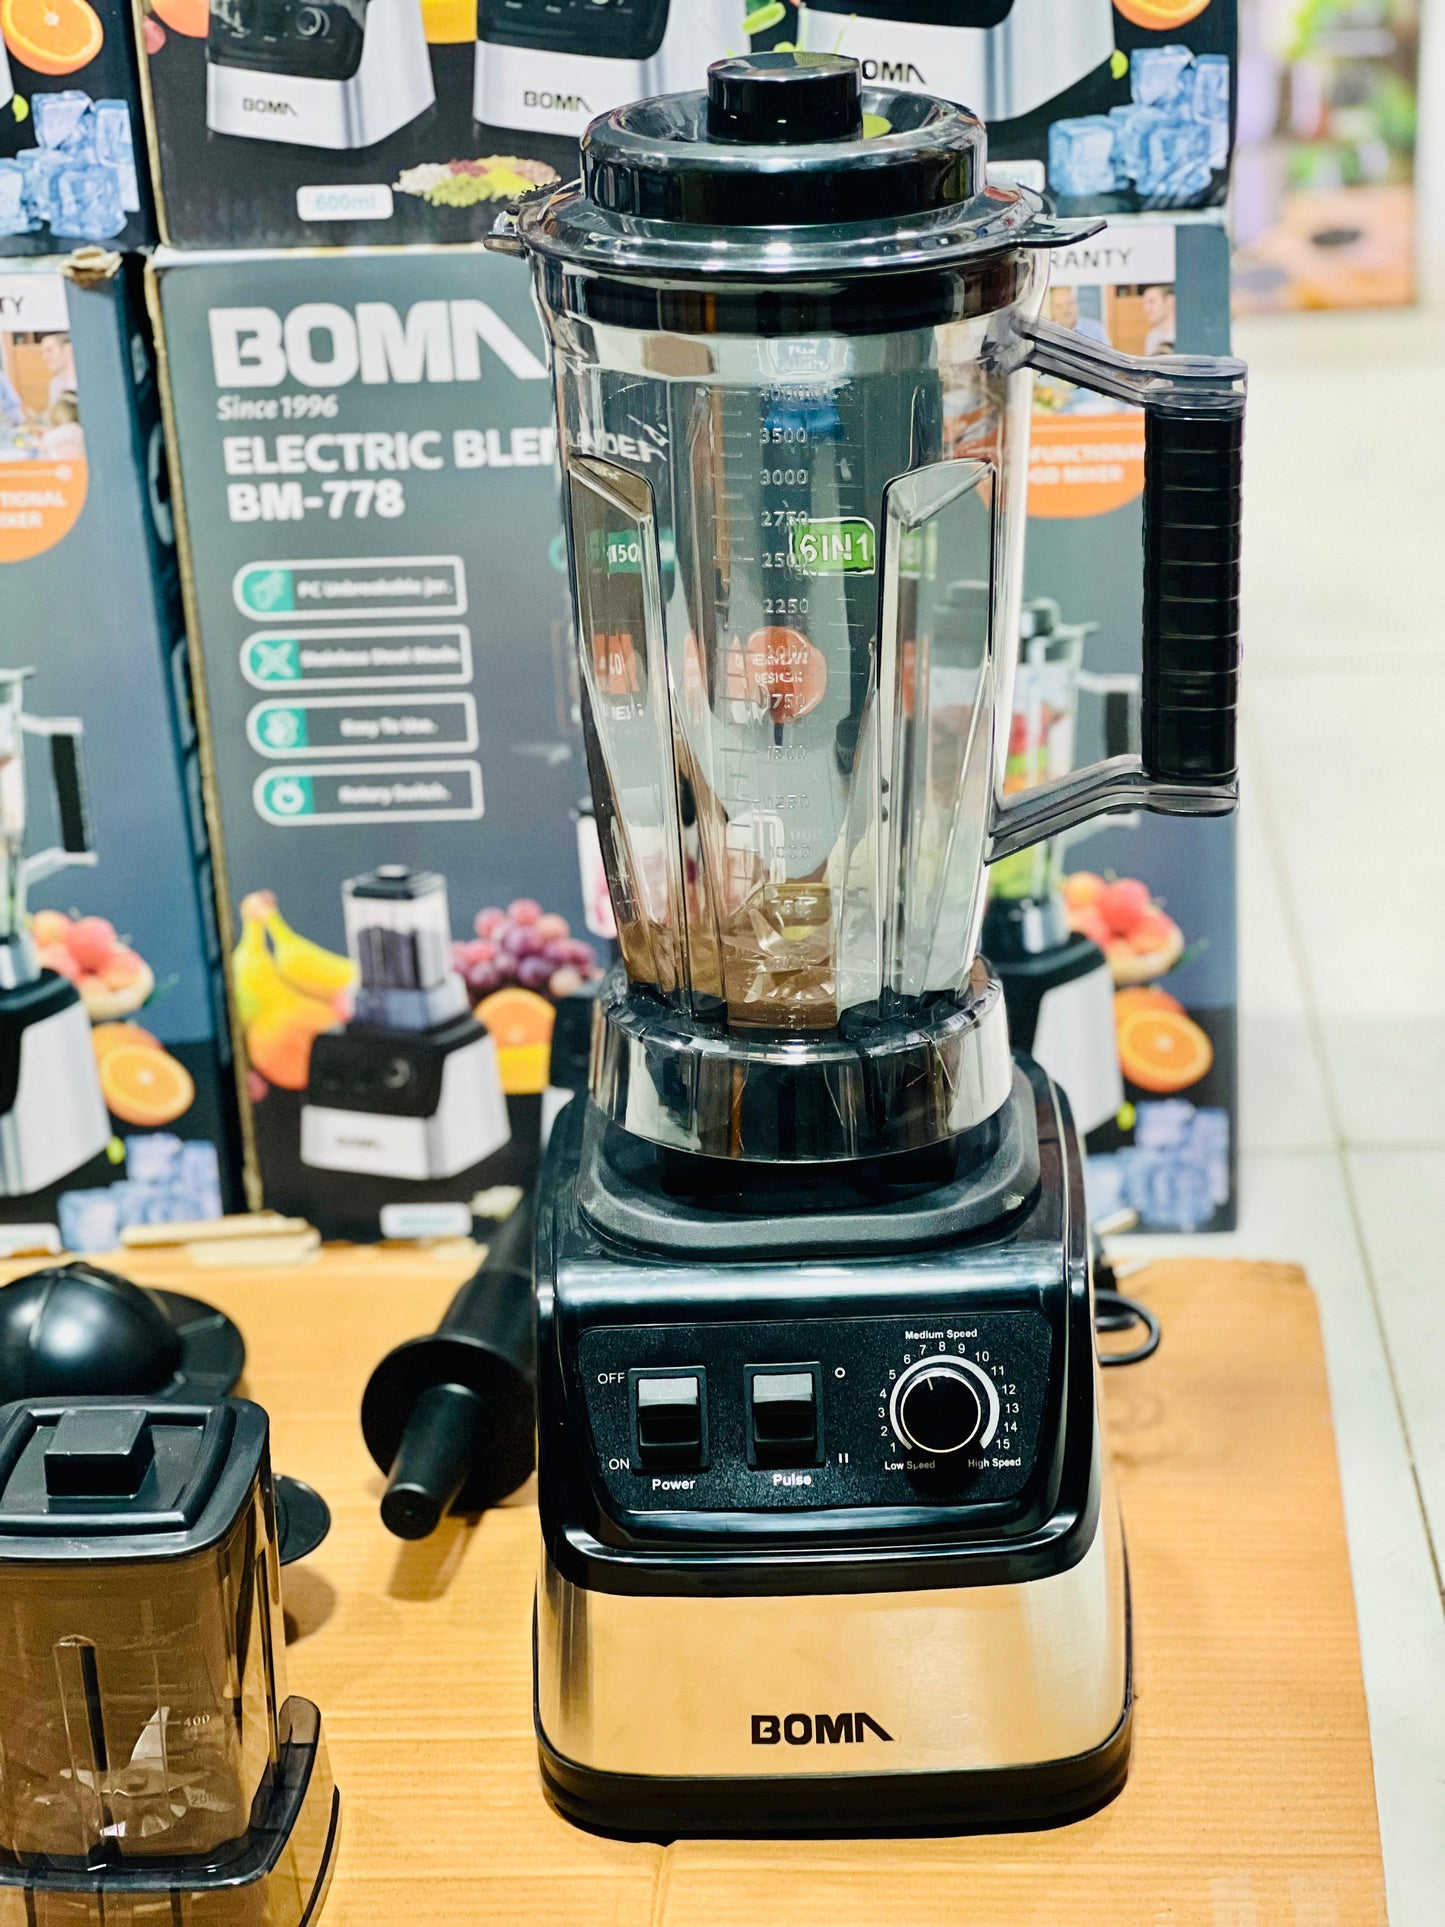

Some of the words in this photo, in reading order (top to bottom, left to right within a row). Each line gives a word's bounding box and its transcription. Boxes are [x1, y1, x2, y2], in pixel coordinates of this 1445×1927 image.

[862, 59, 927, 84] OMA
[242, 97, 299, 118] BOMA
[523, 91, 594, 115] BOMA
[208, 300, 549, 388] BOMA
[216, 394, 278, 421] Since
[279, 394, 339, 419] 1996
[759, 428, 808, 444] 3500
[223, 430, 442, 475] ELECTRIC
[760, 470, 808, 486] 3000
[227, 478, 405, 522] BM-778
[904, 1330, 944, 1340] Medium
[946, 1328, 978, 1340] Speed
[919, 1345, 927, 1355] 7
[938, 1341, 946, 1352] 8
[958, 1343, 966, 1354] 9
[903, 1354, 911, 1365] 6
[975, 1351, 990, 1362] 10
[889, 1370, 896, 1380] 5
[991, 1365, 1005, 1376] 11
[597, 1372, 625, 1385] OFF
[879, 1388, 887, 1399] 4
[1002, 1384, 1016, 1395] 12
[878, 1407, 885, 1418] 3
[1005, 1403, 1020, 1413] 13
[880, 1426, 888, 1437] 2
[1003, 1421, 1018, 1432] 14
[890, 1442, 896, 1453] 1
[996, 1438, 1010, 1449] 15
[608, 1457, 630, 1470] ON
[884, 1460, 904, 1471] Low
[906, 1460, 936, 1471] Speed
[967, 1458, 990, 1469] High
[991, 1457, 1022, 1468] Speed
[651, 1477, 696, 1491] Power
[772, 1473, 812, 1487] Pulse
[183, 1713, 211, 1727] 400
[750, 1711, 895, 1746] BOMA
